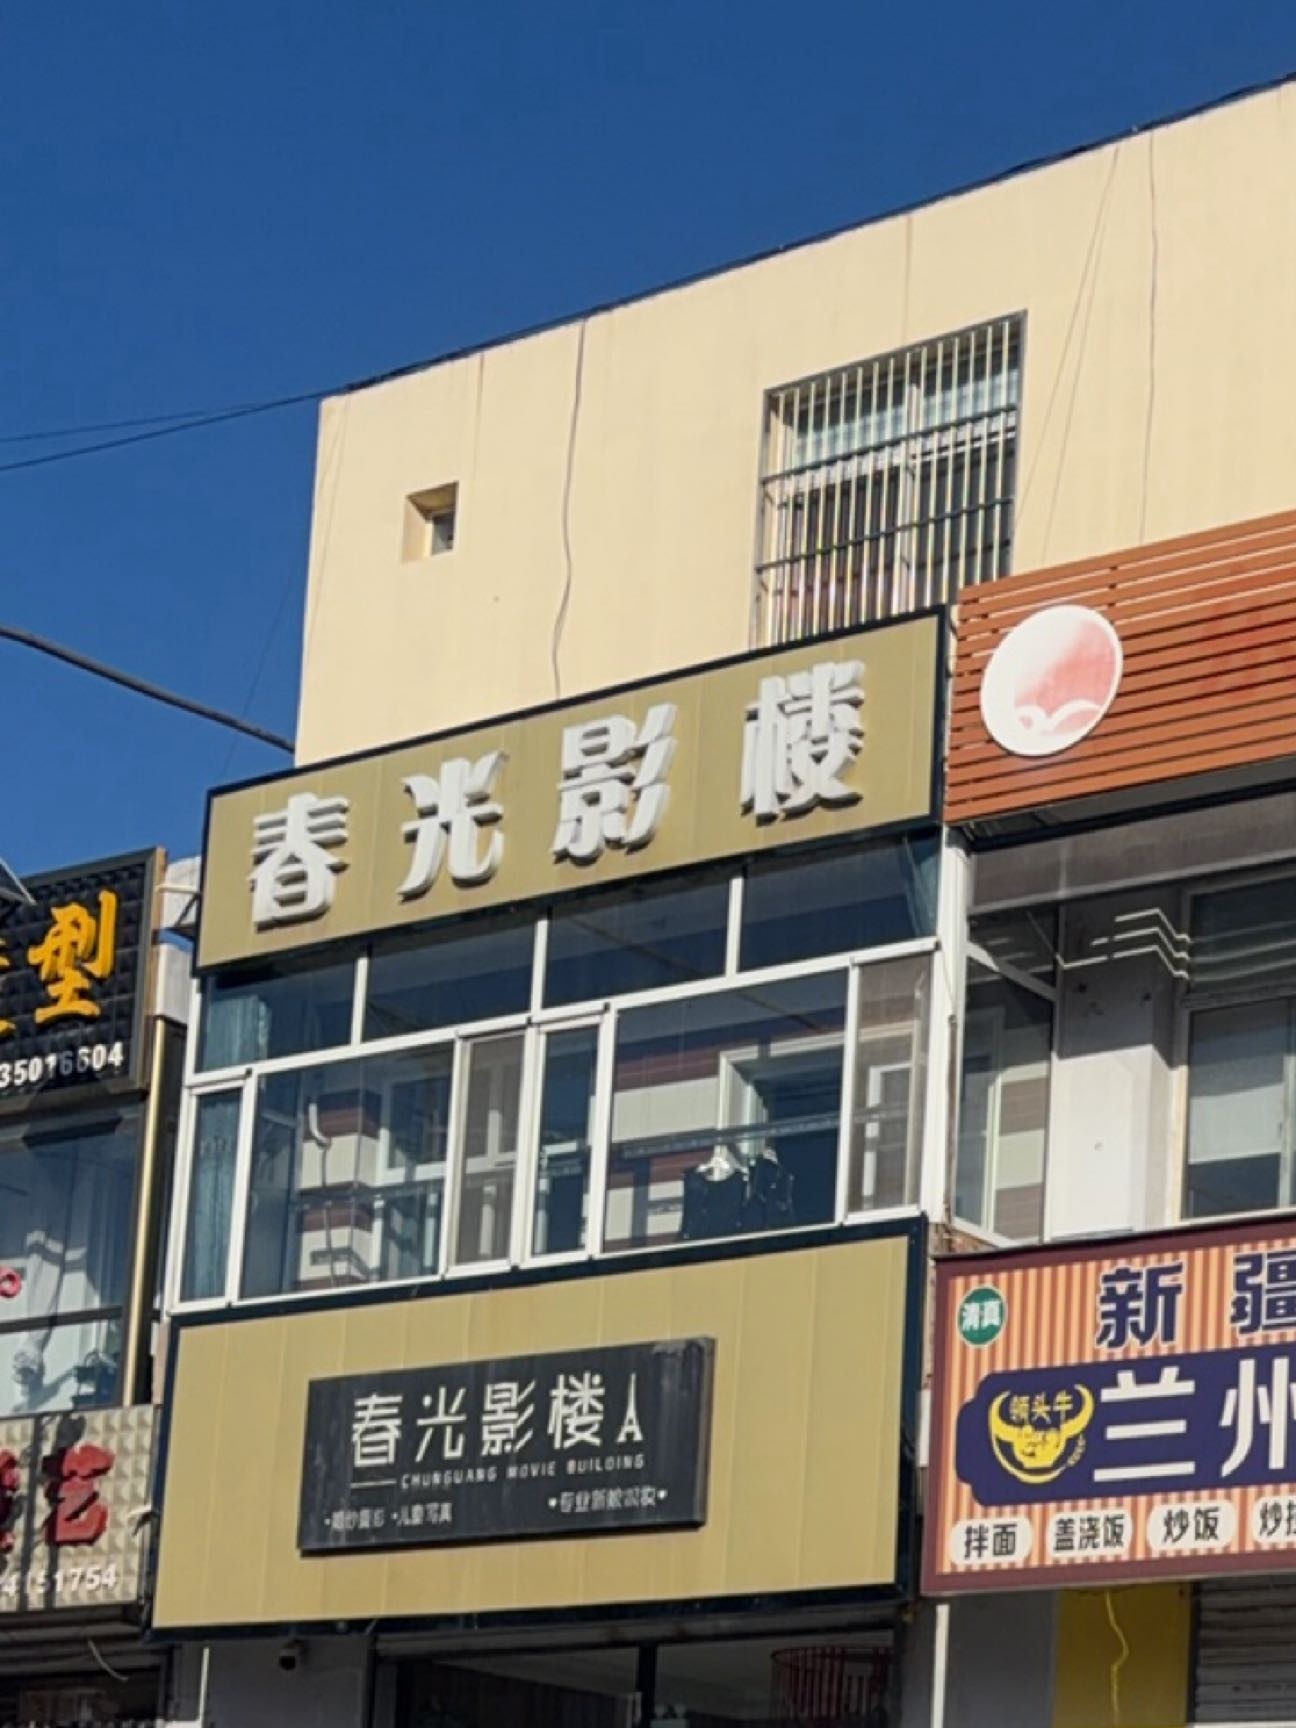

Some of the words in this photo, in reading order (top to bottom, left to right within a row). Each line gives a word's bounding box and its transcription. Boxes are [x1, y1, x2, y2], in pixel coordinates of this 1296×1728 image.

[250, 660, 866, 928] 春光影楼
[0, 888, 118, 1034] 型
[350, 1370, 606, 1468] 春光影楼
[964, 1523, 1018, 1559] 拌面
[1053, 1513, 1125, 1552] 盖浇饭
[1162, 1506, 1220, 1543] 炒饭
